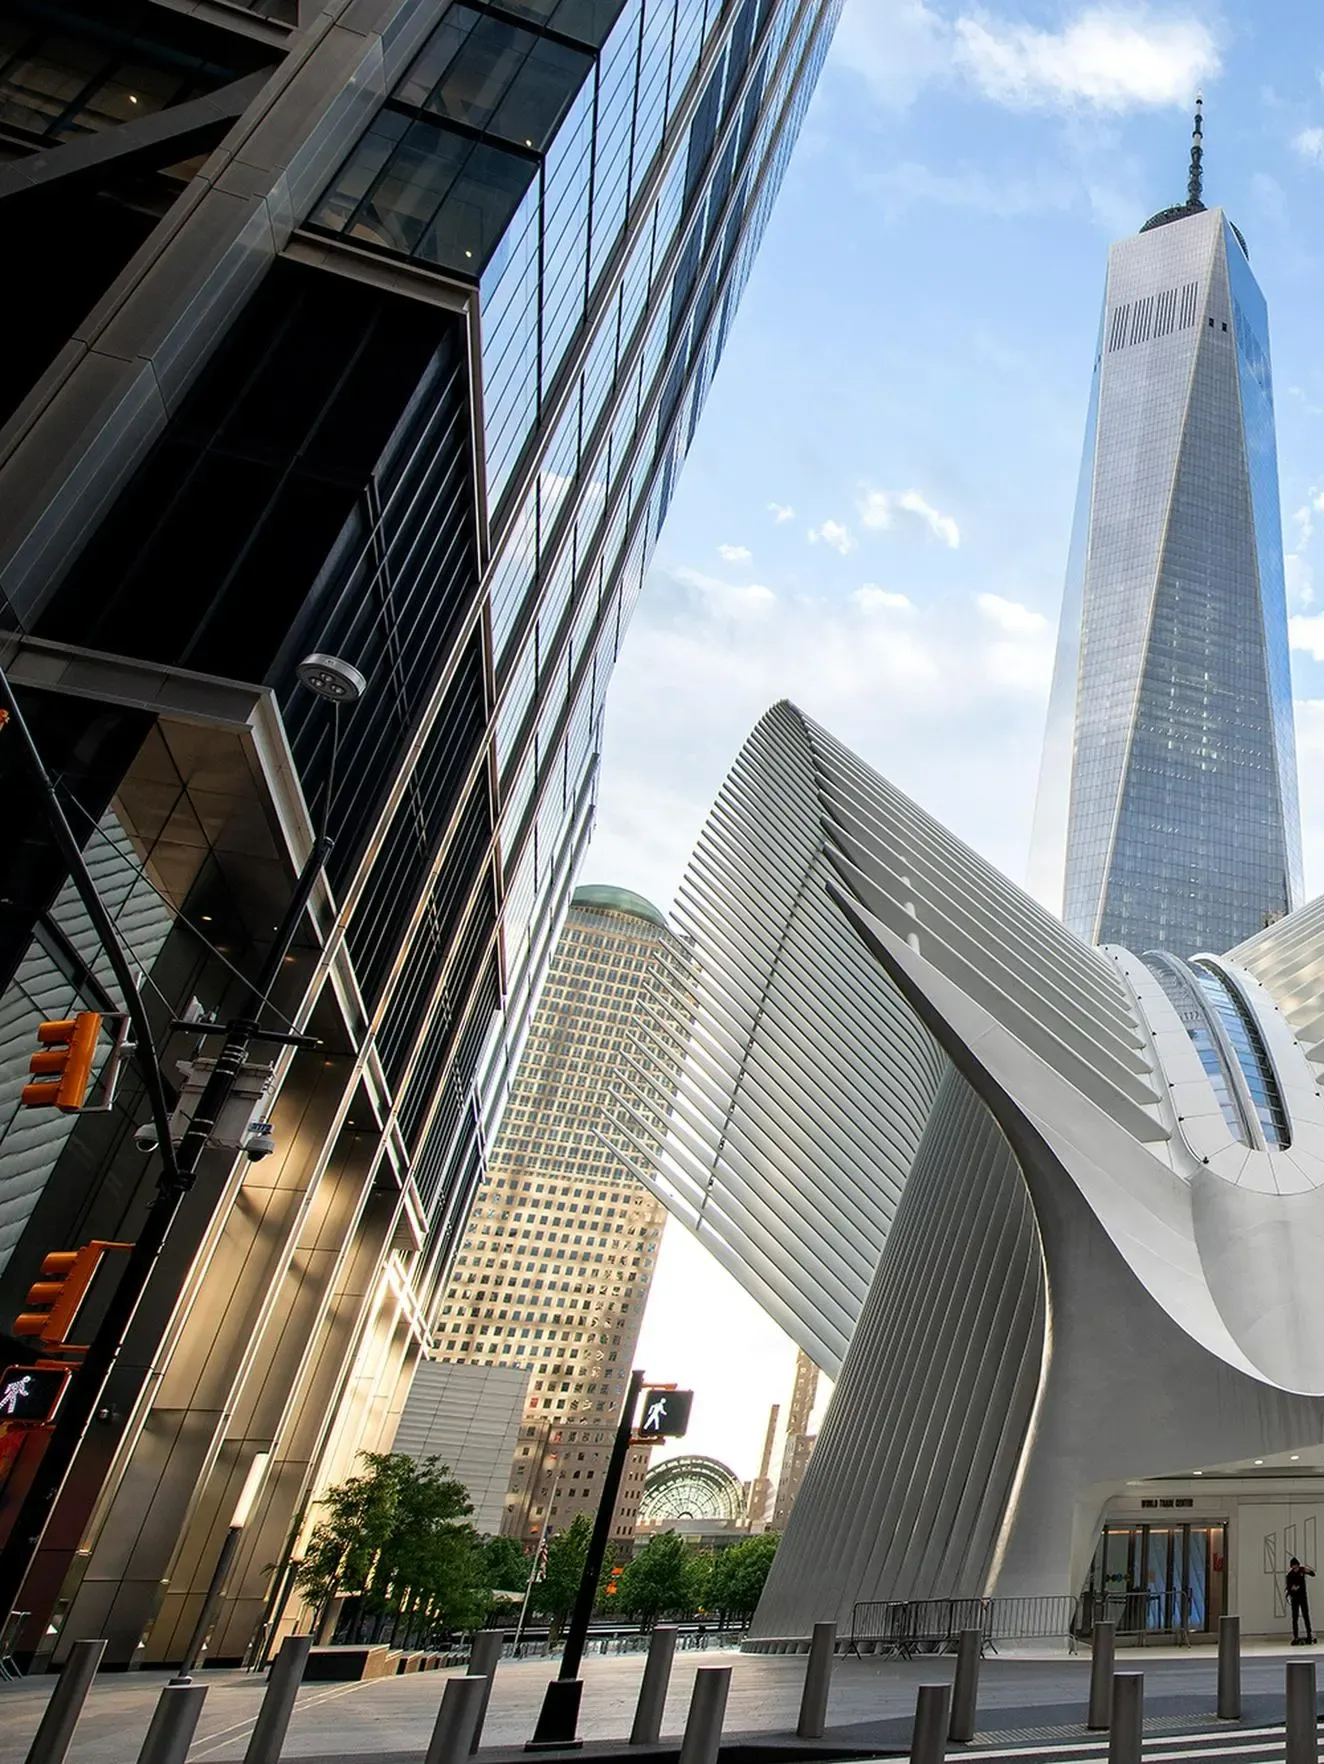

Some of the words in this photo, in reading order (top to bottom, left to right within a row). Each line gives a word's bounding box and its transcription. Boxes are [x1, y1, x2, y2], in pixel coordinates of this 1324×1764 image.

[1141, 1499, 1158, 1508] WORLD
[1159, 1499, 1174, 1508] TRADE
[1175, 1498, 1193, 1507] CENTER
